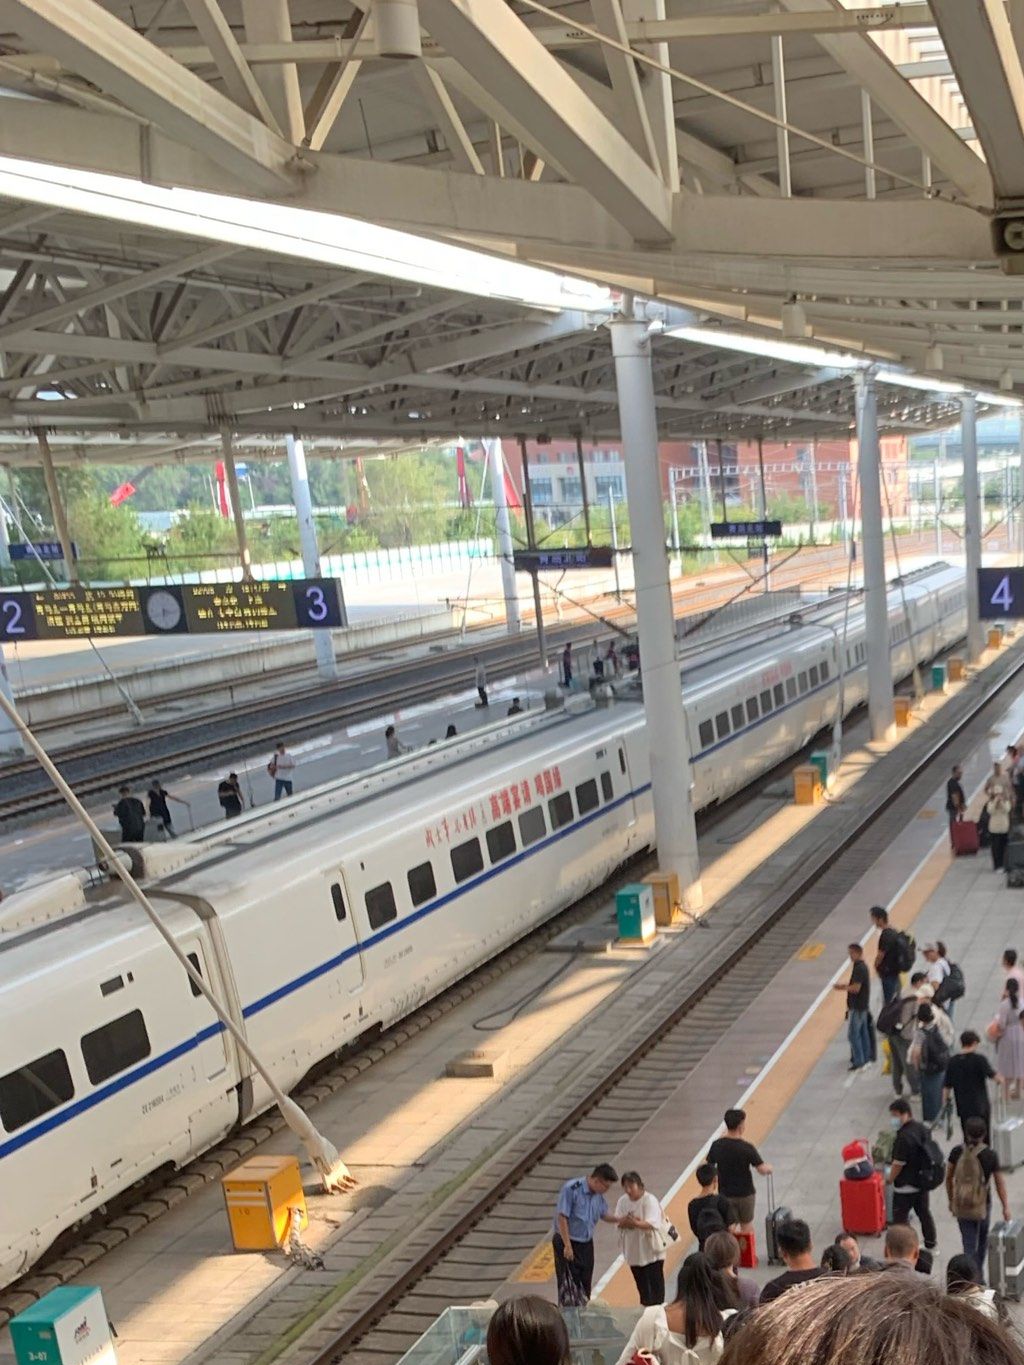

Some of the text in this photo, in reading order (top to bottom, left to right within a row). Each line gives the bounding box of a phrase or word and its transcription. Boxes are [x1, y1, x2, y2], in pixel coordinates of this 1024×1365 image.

[306, 586, 327, 621] 3
[990, 575, 1014, 611] 4
[3, 600, 25, 633] 2
